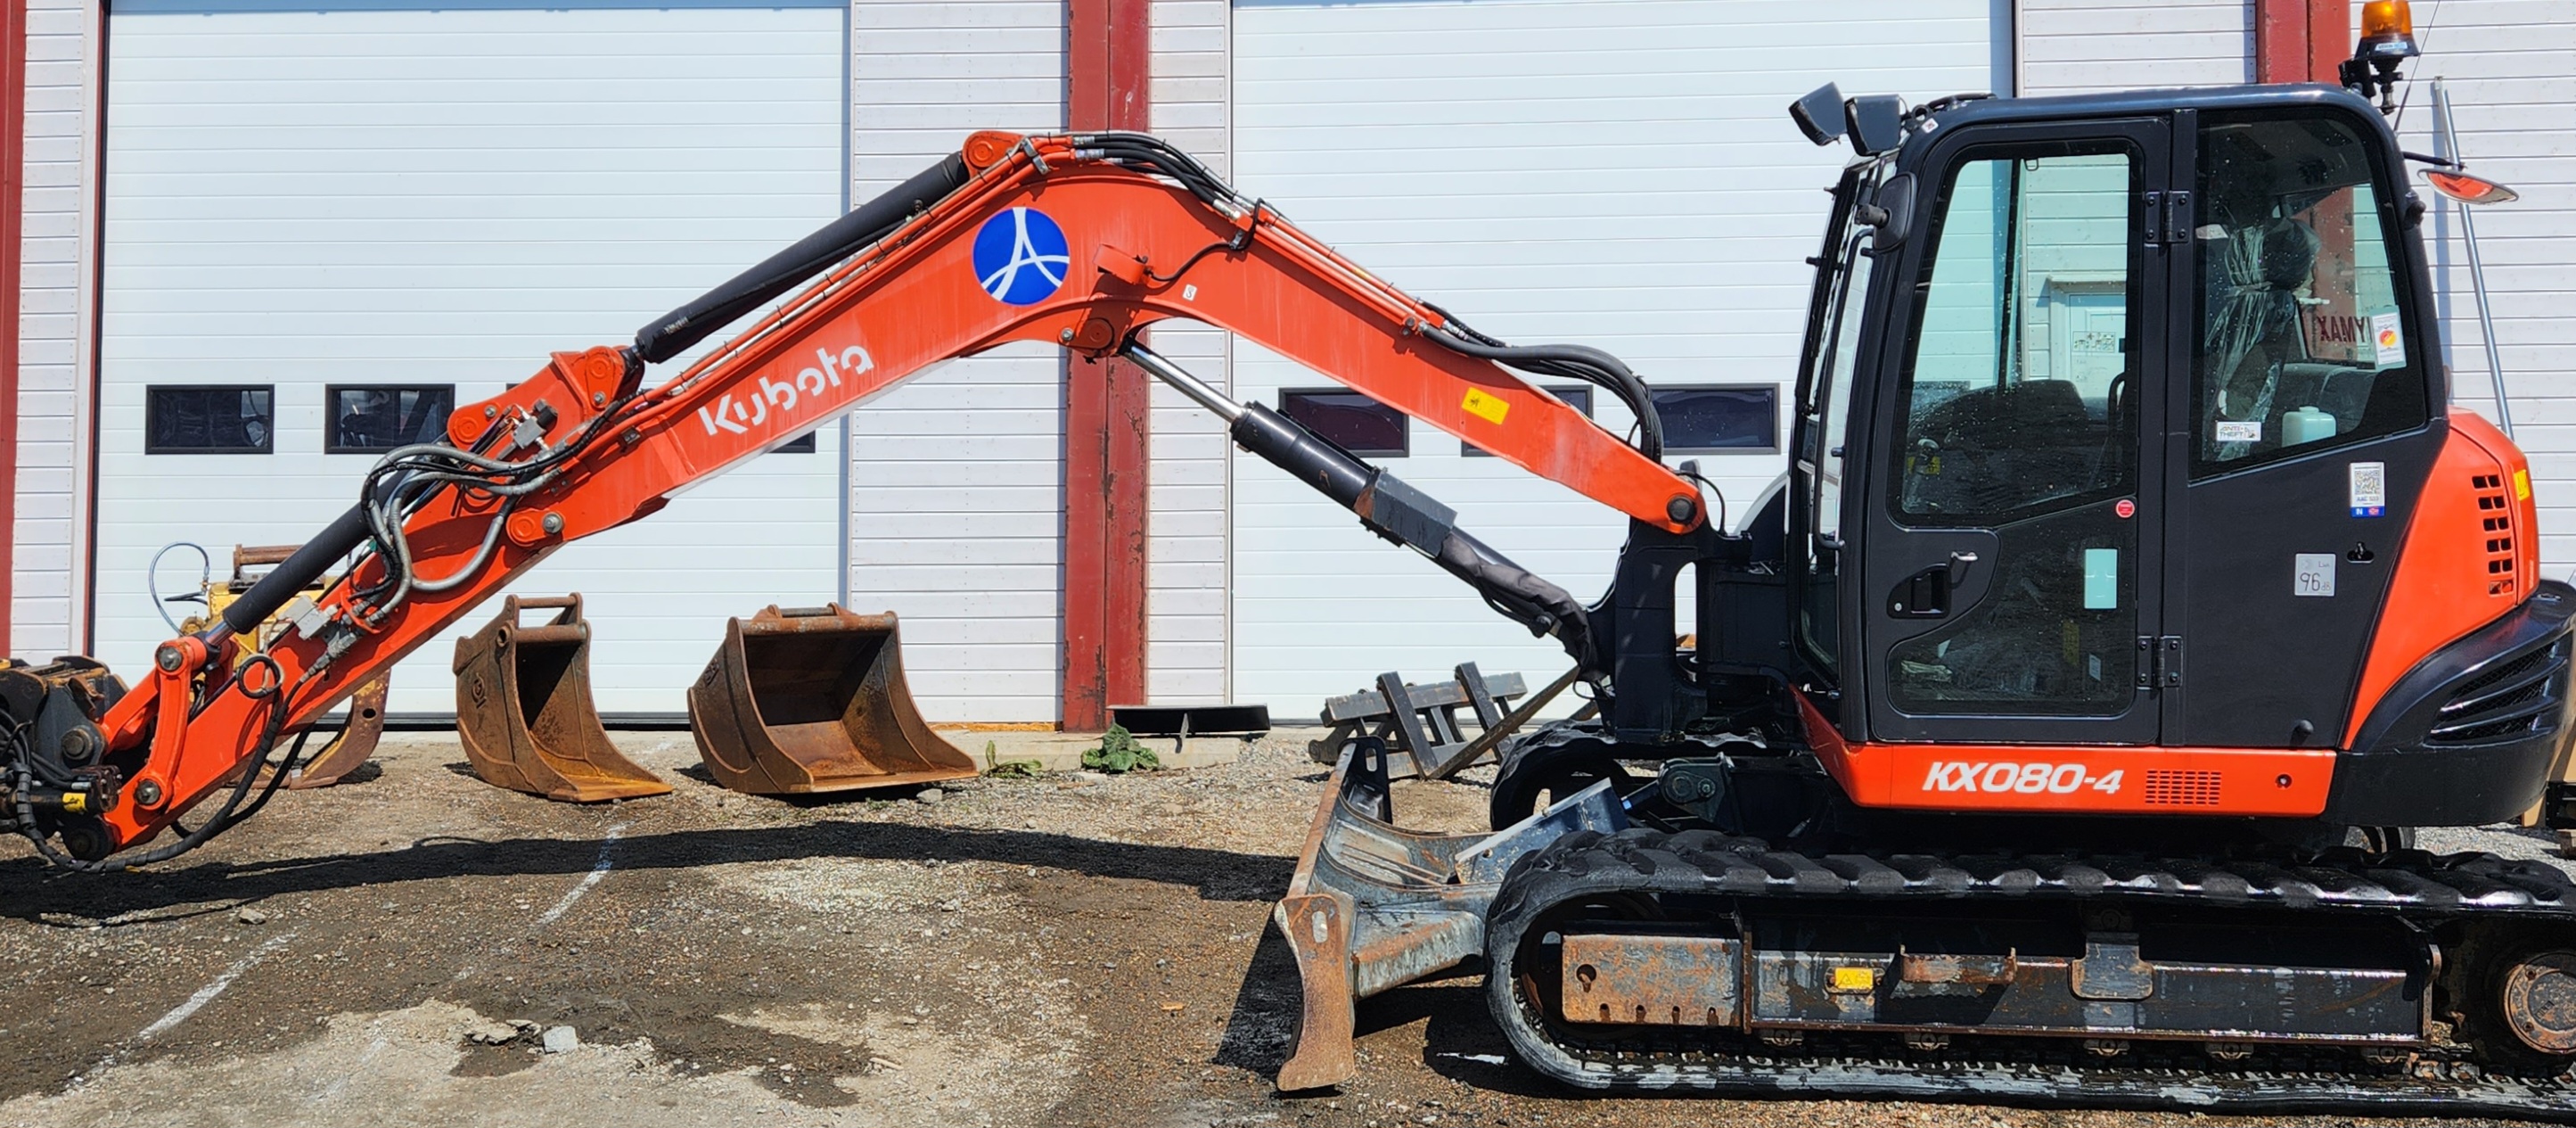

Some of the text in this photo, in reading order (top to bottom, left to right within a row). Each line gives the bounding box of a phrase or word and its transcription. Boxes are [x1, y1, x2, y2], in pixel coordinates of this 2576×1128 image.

[698, 345, 874, 436] Kubota
[2300, 572, 2321, 591] 96
[1922, 762, 2124, 794] KX080-4
